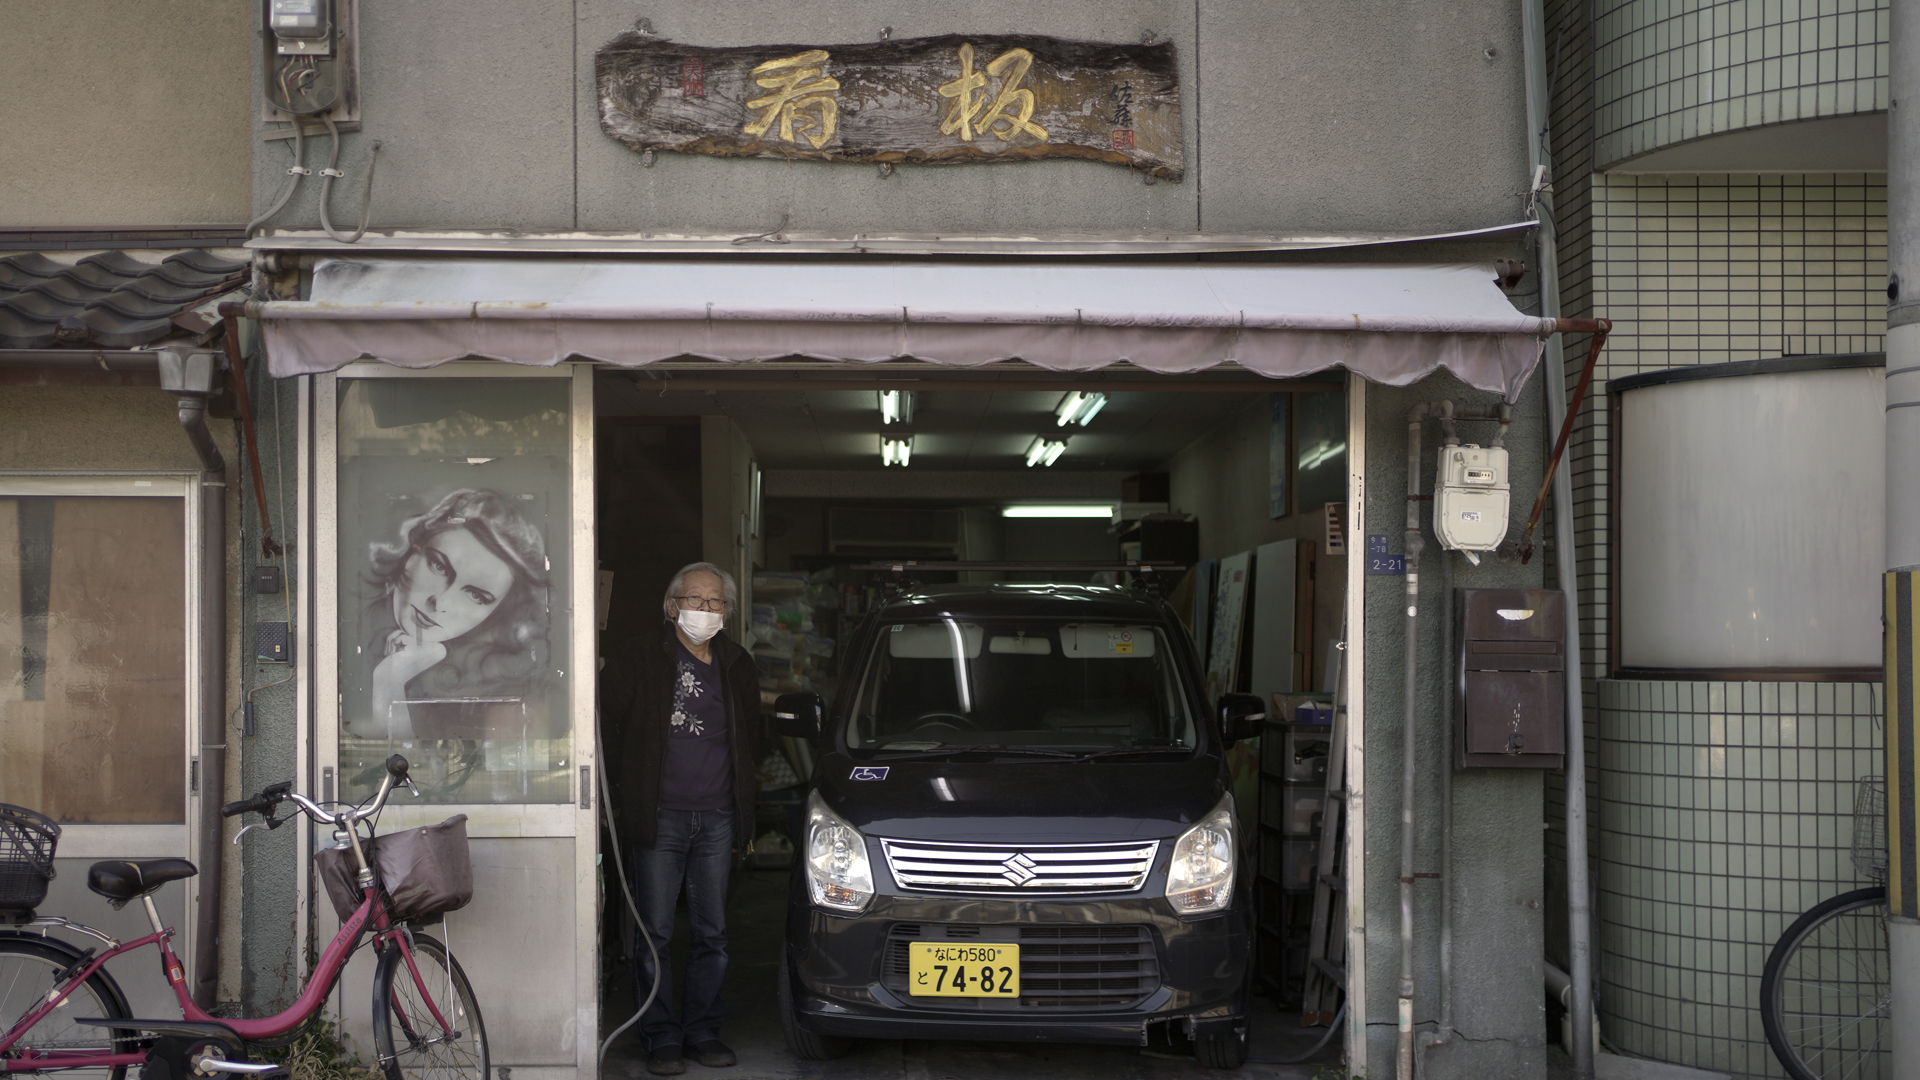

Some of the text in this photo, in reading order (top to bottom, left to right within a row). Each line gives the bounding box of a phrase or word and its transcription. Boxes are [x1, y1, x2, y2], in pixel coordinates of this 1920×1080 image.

[743, 43, 1049, 149] 看板
[1373, 559, 1402, 570] 2-21
[337, 917, 362, 947] Assista
[917, 965, 1013, 993] と 74-82
